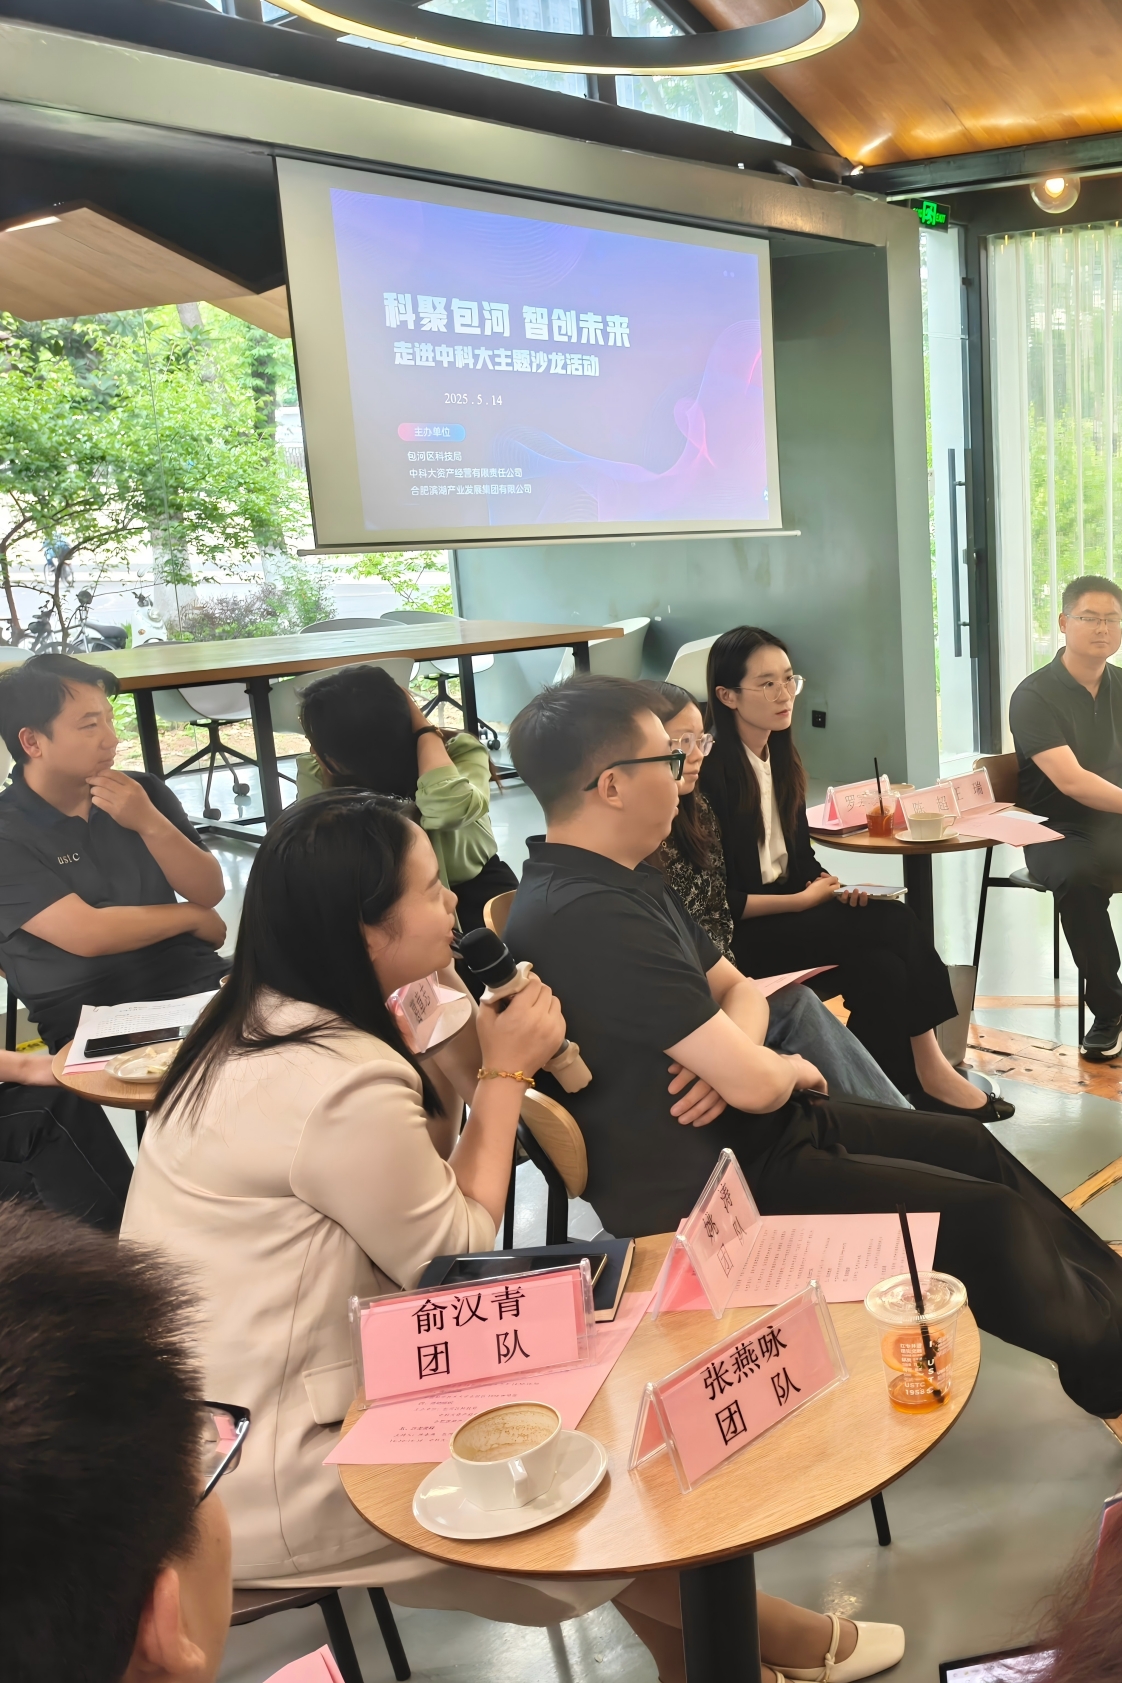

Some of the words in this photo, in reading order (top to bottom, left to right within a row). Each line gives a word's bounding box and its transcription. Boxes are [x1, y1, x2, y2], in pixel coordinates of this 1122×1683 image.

[383, 292, 510, 337] 科聚包河
[522, 305, 631, 348] 智创未来
[393, 340, 600, 377] 走进中科大主题沙龙活动
[414, 426, 451, 437] 主办单位
[407, 451, 462, 462] 包河区科技局
[409, 467, 523, 479] 中科大资产经营有限责任公司
[410, 483, 532, 496] 合肥滨湖产业发展集团有限公司
[411, 1285, 526, 1334] 俞汉青
[699, 1325, 788, 1401] 张燕咏
[905, 1388, 925, 1396] 1958
